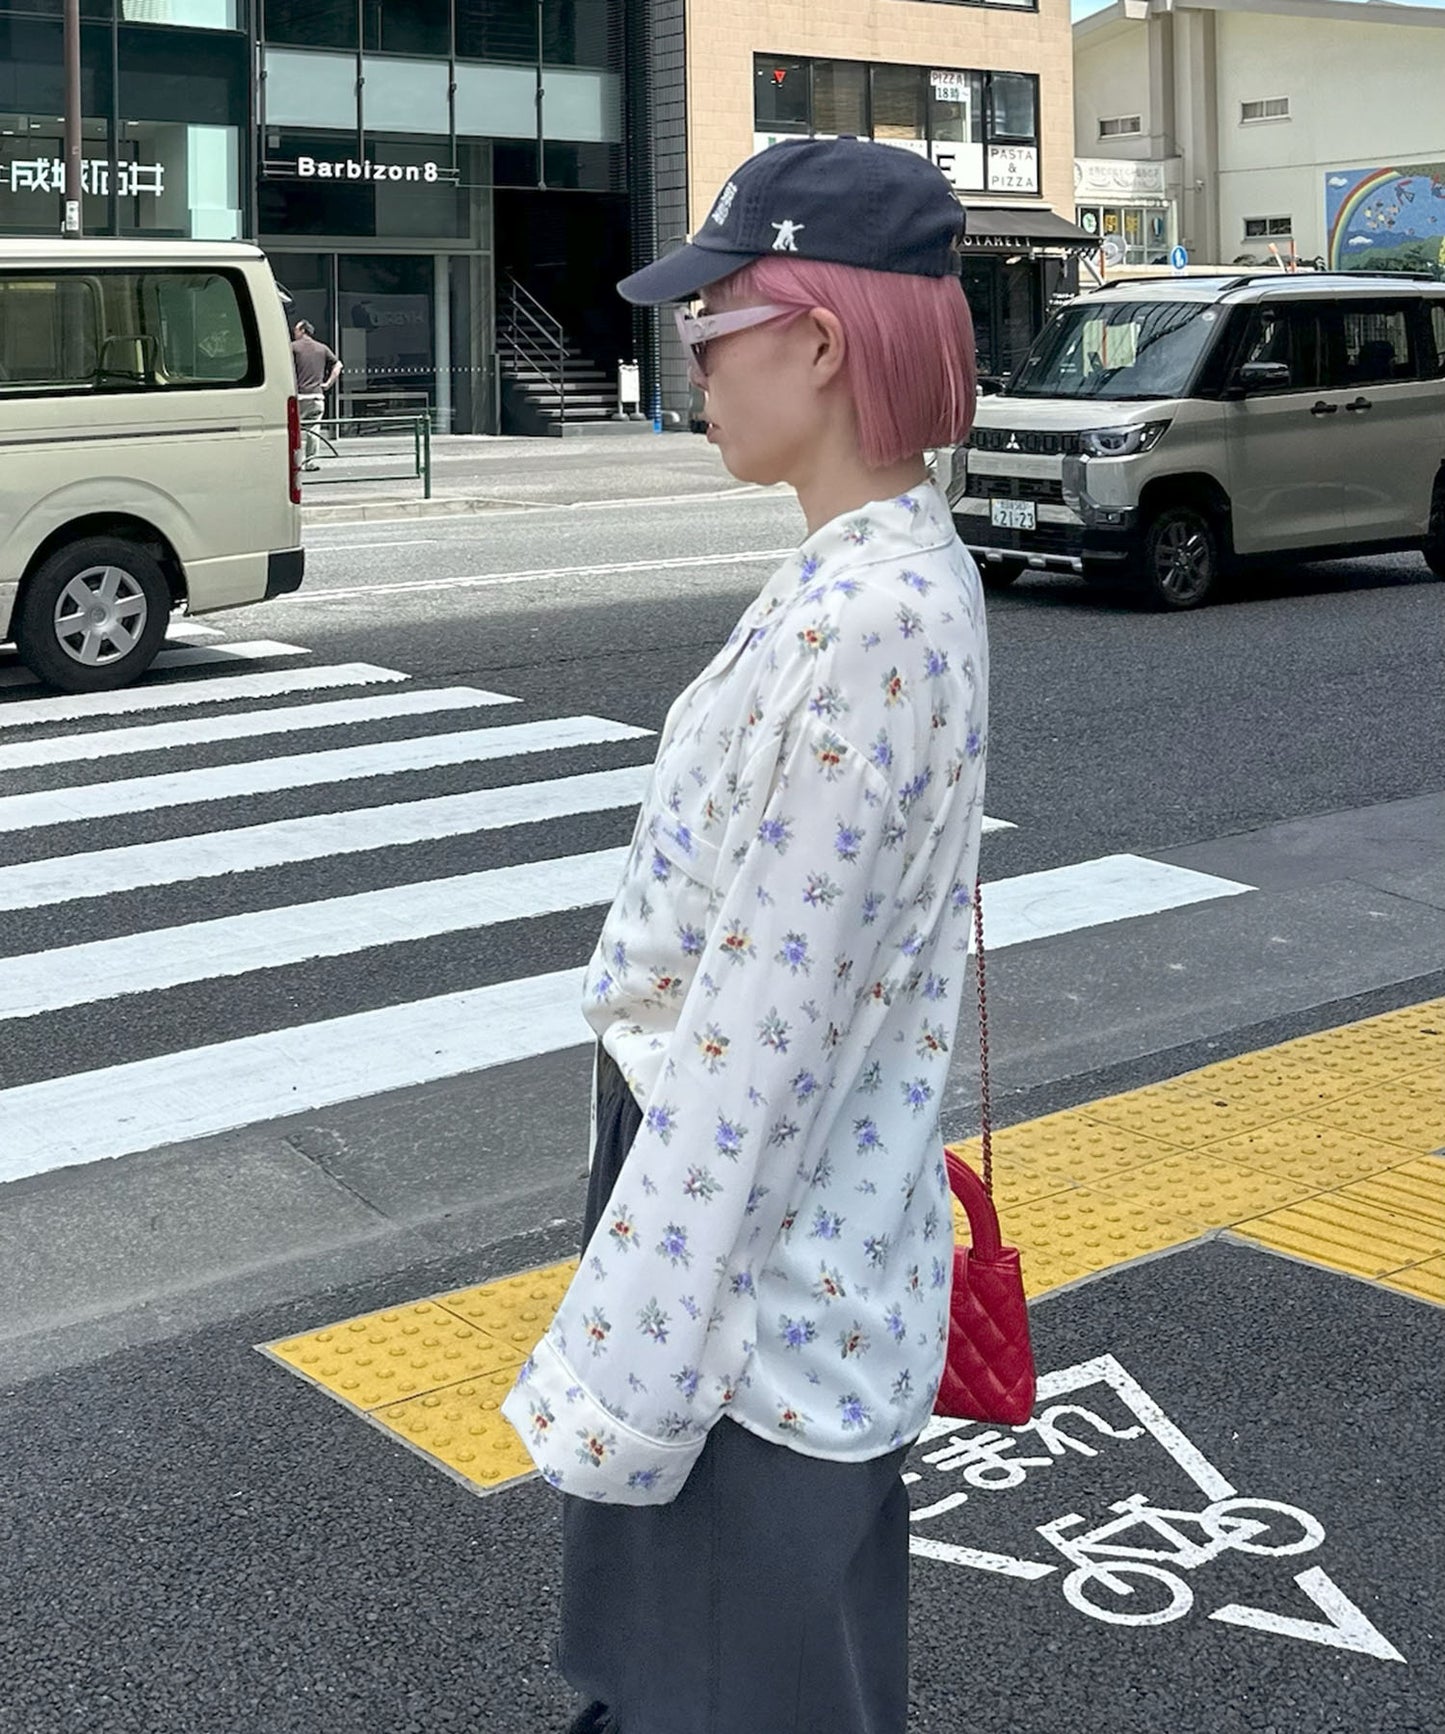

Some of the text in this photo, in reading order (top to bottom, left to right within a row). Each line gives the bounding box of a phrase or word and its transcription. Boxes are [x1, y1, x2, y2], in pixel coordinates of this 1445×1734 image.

[931, 72, 964, 85] PIZZA
[990, 148, 1033, 161] PASTA
[1008, 162, 1017, 173] &
[991, 175, 1034, 187] PIZZA
